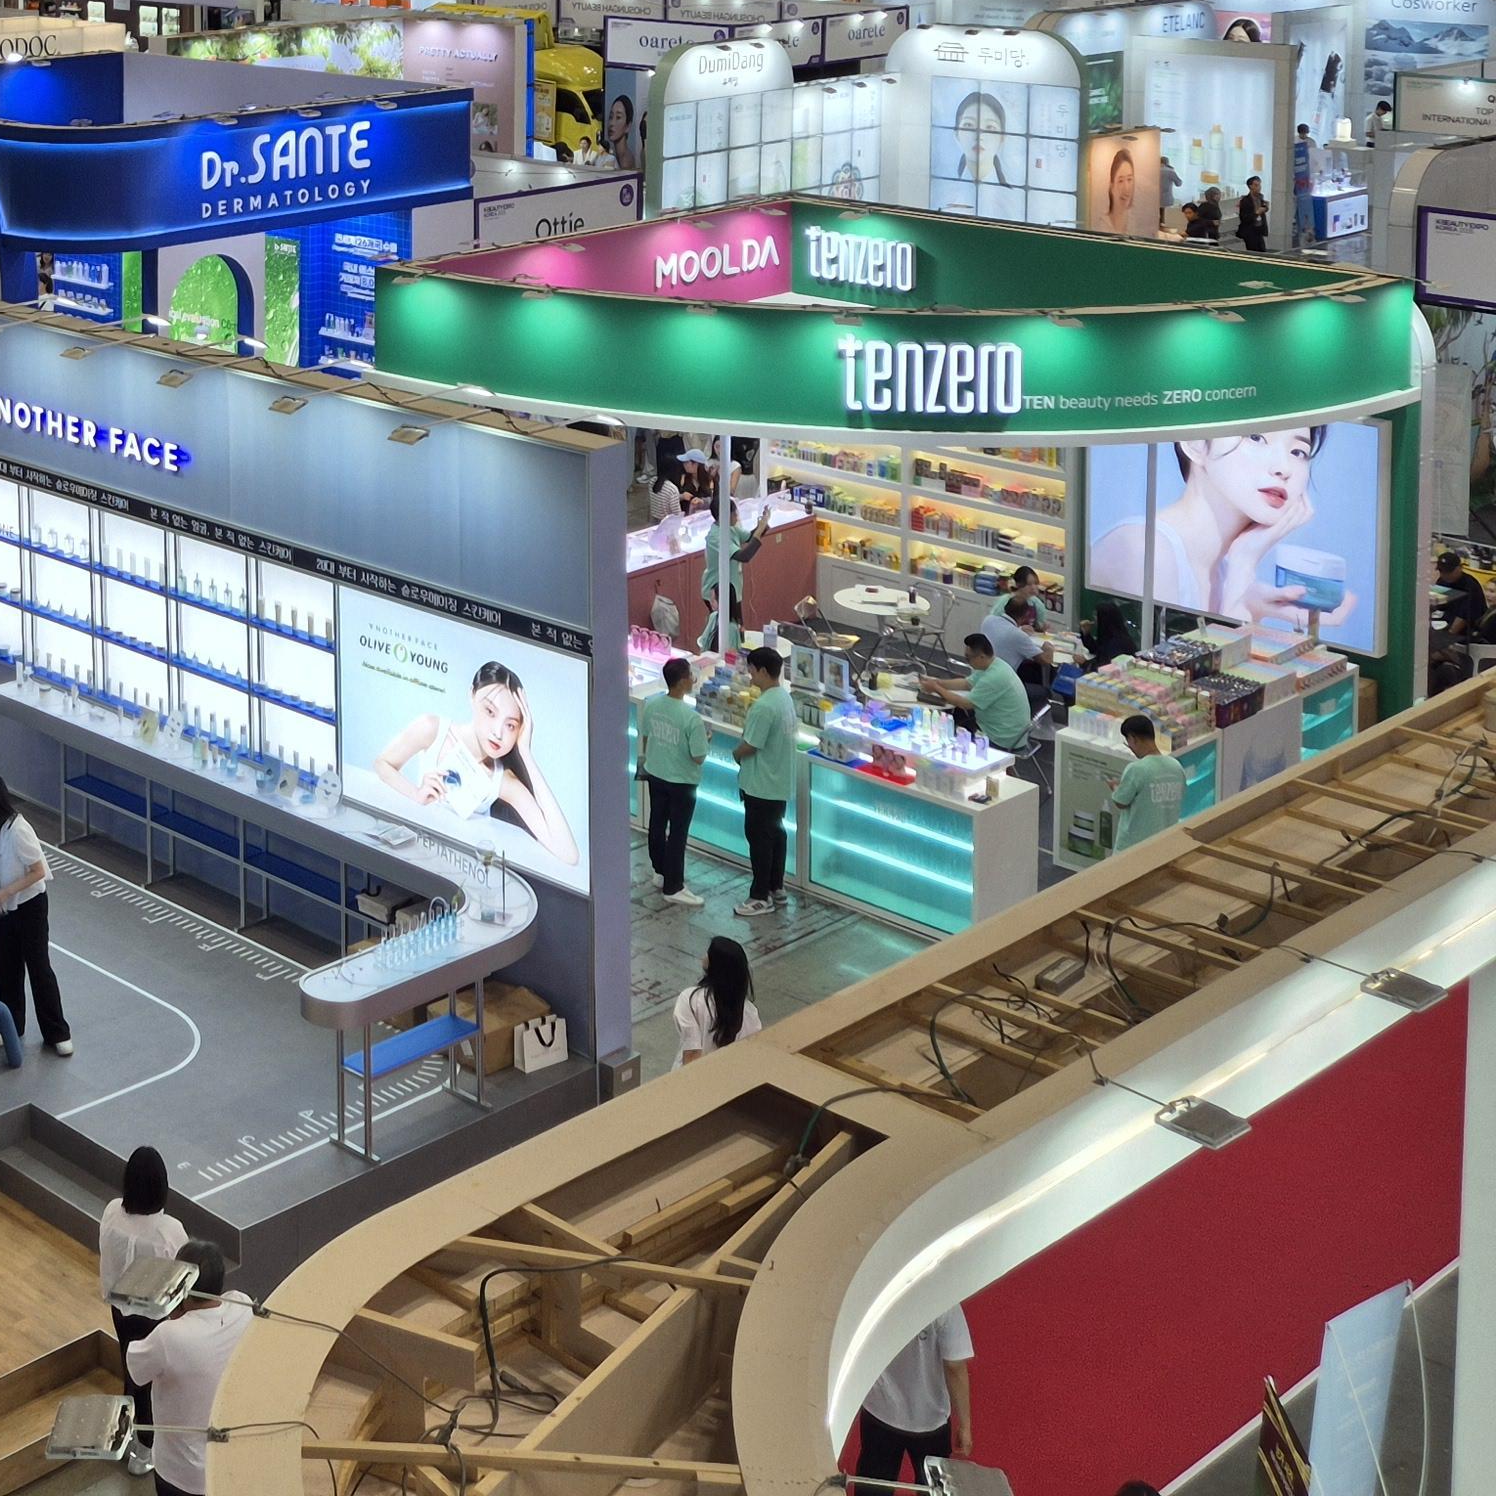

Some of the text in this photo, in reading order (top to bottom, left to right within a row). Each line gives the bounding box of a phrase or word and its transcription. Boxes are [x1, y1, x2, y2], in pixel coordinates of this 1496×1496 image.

[419, 46, 451, 58] PRETTY
[699, 53, 764, 75] DumiDang
[978, 47, 1027, 68] 두미당
[202, 178, 371, 219] DERMATOLOGY
[655, 235, 780, 289] MOOLDA
[805, 225, 917, 292] tenzero
[837, 333, 1023, 415] tenzero
[1023, 386, 1257, 411] TEN beauty needs ZERO concern
[109, 427, 178, 472] FACE
[9, 464, 23, 479] 부터
[26, 469, 53, 486] 시작하는
[101, 492, 129, 512] 스킨케어
[172, 514, 188, 529] 없는
[238, 534, 254, 550] 없는
[259, 540, 291, 561] 스킨케어
[316, 558, 501, 626] 20대 부터 시작하는 슬로우에이징 스킨케어
[360, 635, 448, 673] OLIVE YOUNG
[532, 622, 583, 649] 본 적 없는
